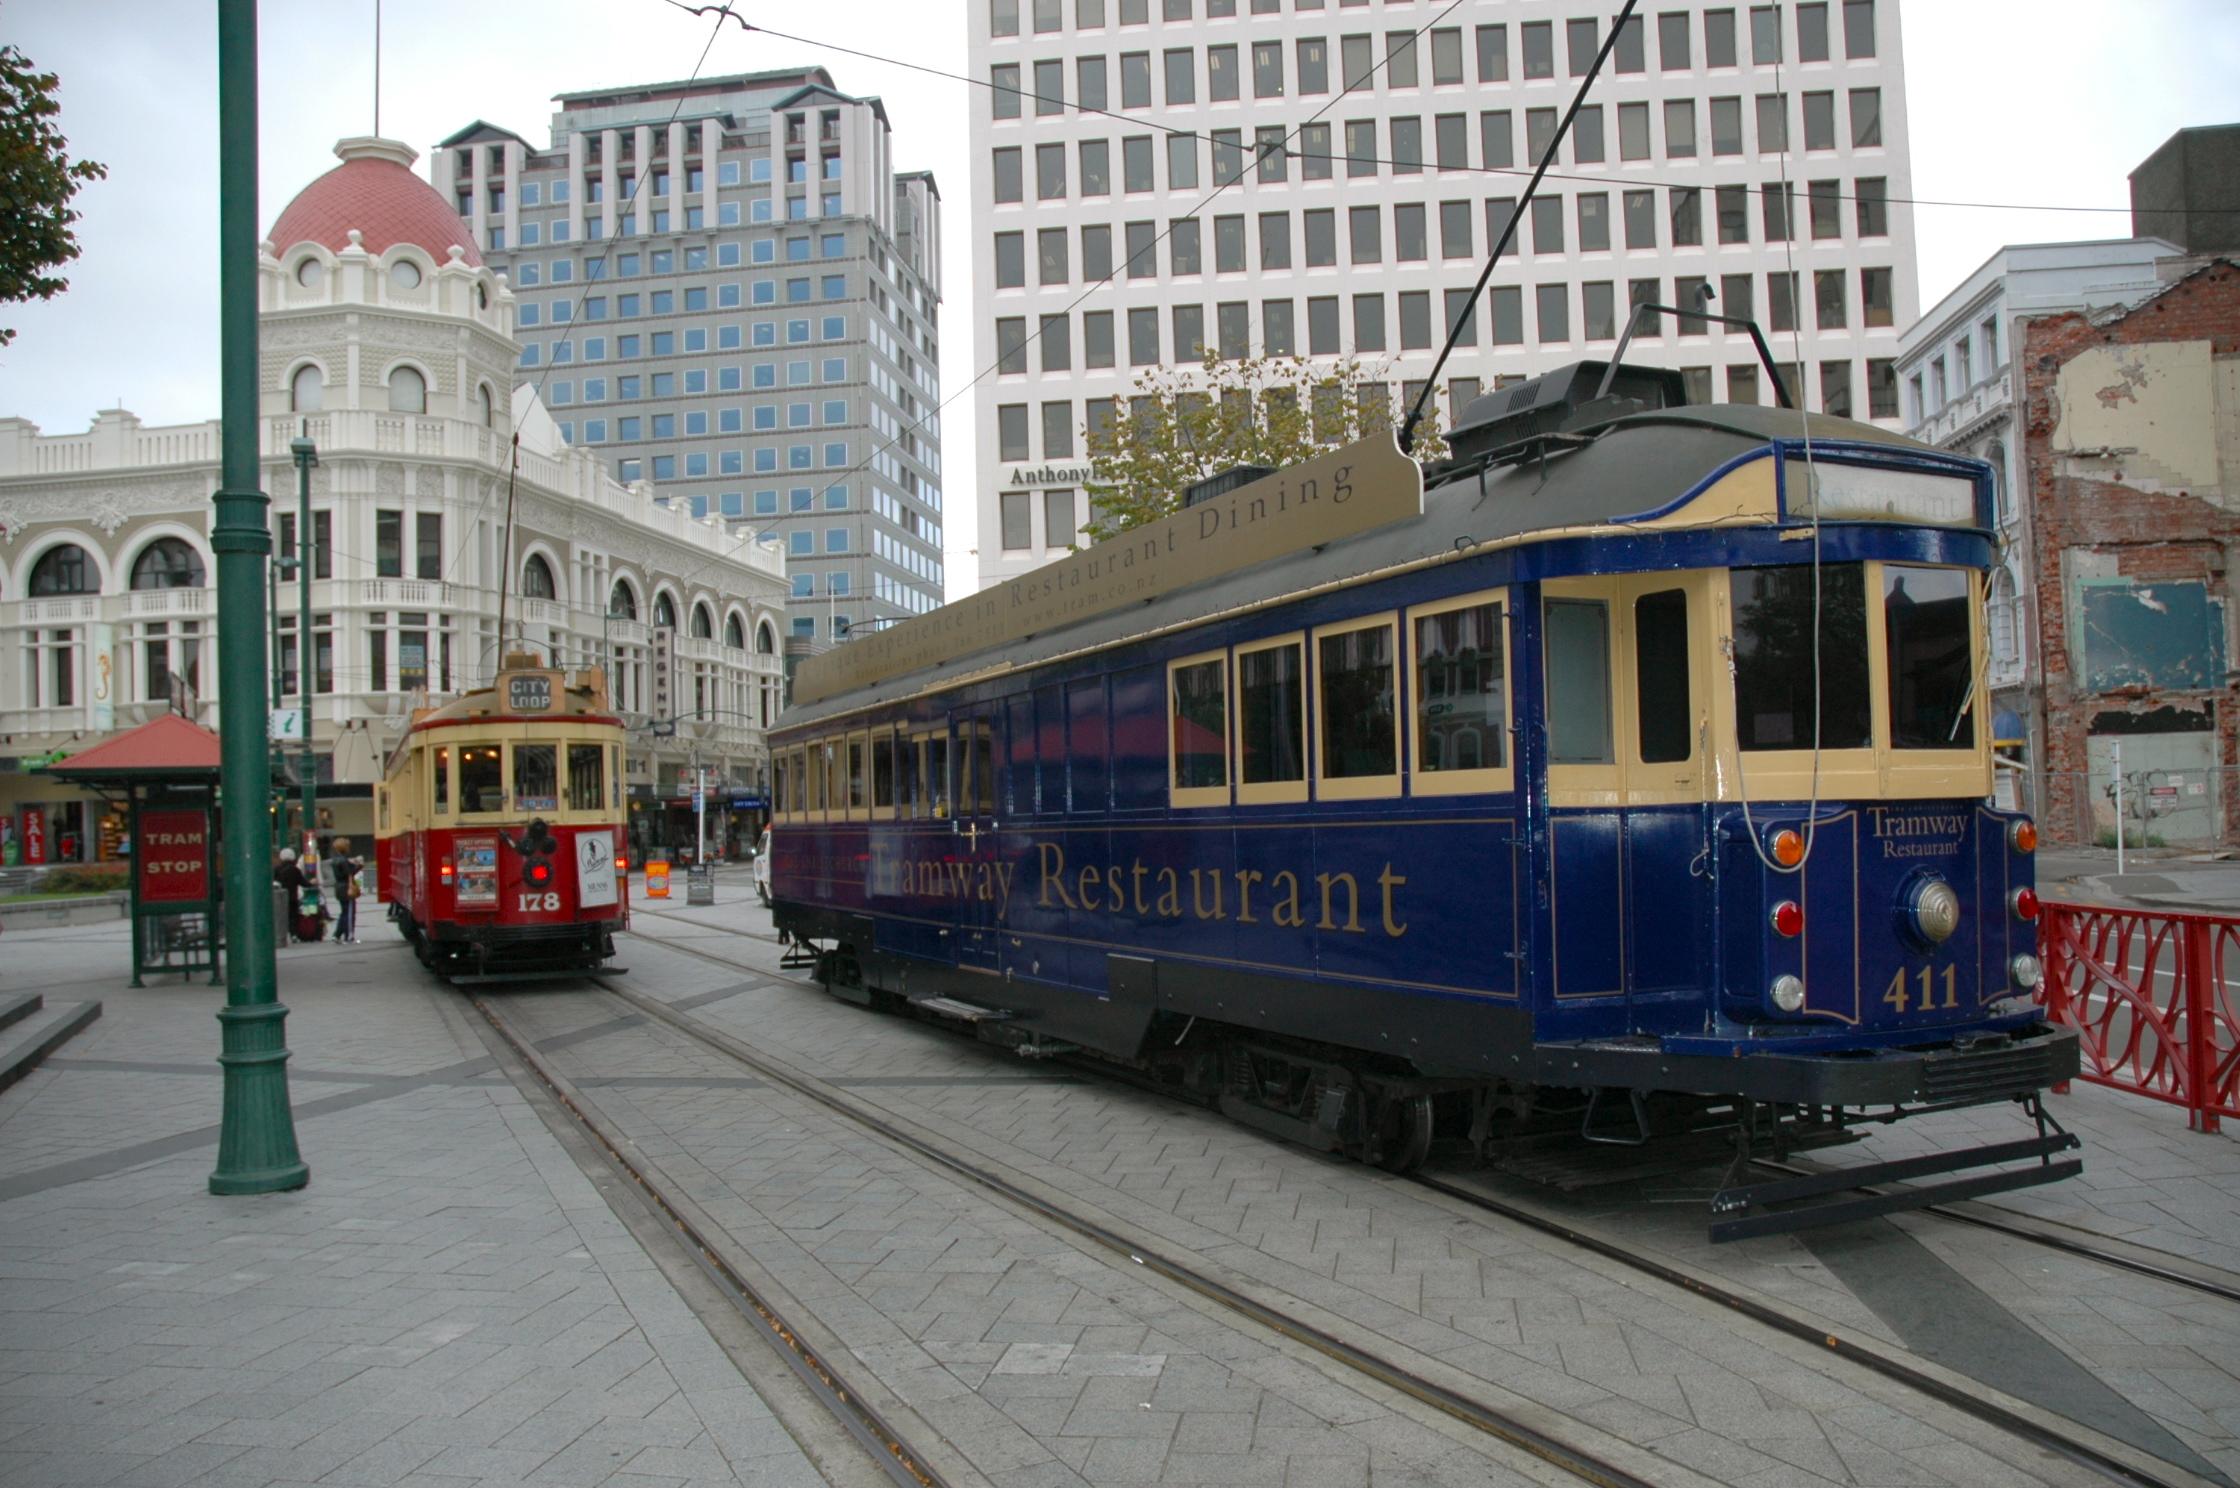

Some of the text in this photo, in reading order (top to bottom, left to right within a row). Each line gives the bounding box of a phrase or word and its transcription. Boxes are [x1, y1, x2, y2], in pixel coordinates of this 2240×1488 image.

[1010, 465, 1090, 484] Anthony
[866, 609, 964, 659] Experience
[976, 595, 997, 620] in
[1010, 527, 1175, 607] Restaurant
[1199, 465, 1354, 540] Dining
[1022, 573, 1157, 628] www.tram.co.nz
[510, 681, 550, 694] CITY
[656, 631, 667, 719] REGENT
[510, 696, 551, 709] LOOP
[27, 812, 41, 858] SALE
[145, 832, 202, 845] TRAM
[1867, 806, 1968, 843] Tramway
[1883, 840, 1959, 859] Restaurant
[147, 861, 202, 874] STOP
[518, 892, 561, 912] 178
[870, 841, 1408, 938] Tramway Restaurant
[1883, 962, 1960, 1013] 411
